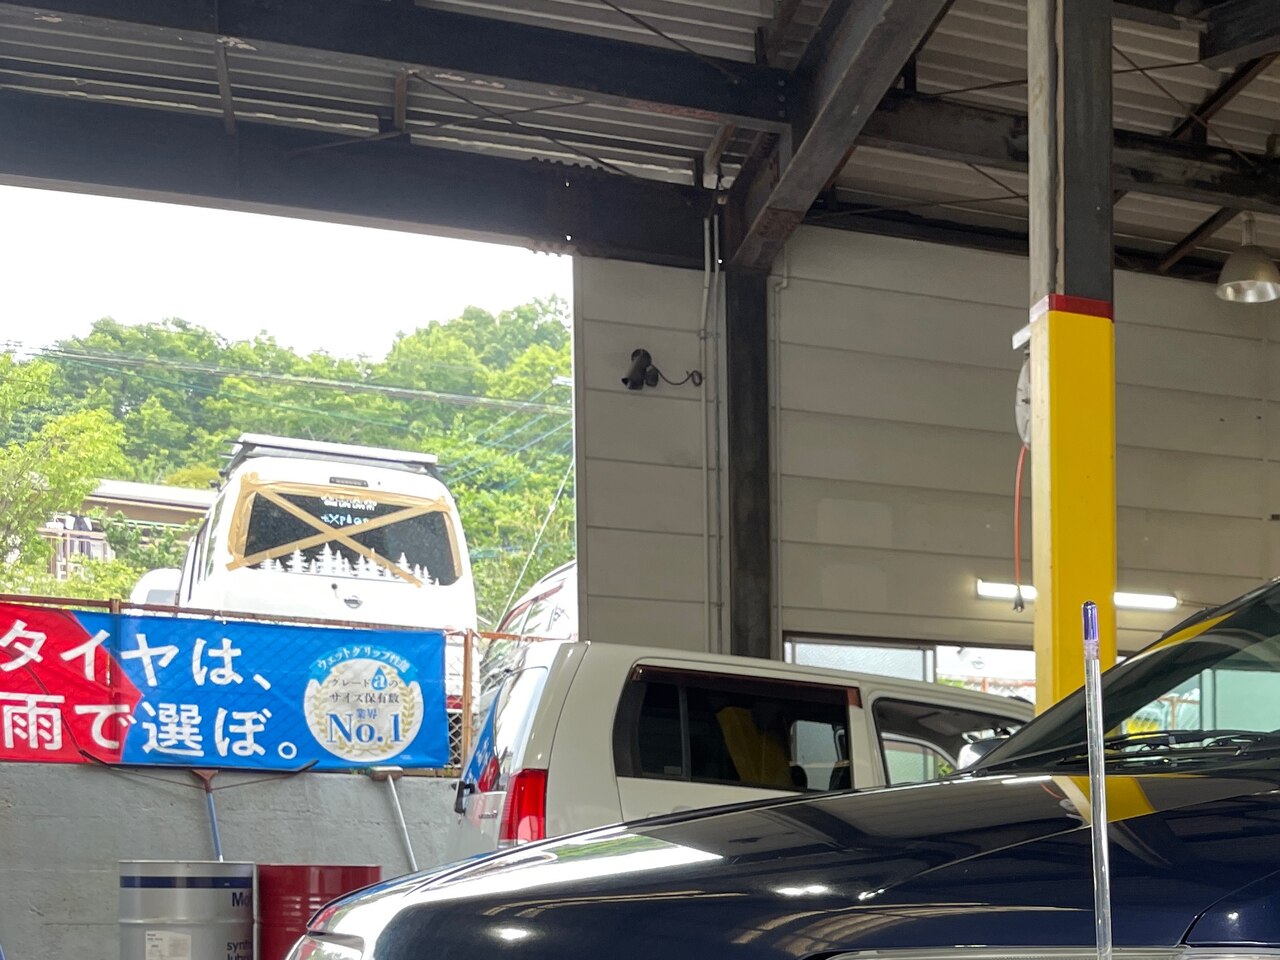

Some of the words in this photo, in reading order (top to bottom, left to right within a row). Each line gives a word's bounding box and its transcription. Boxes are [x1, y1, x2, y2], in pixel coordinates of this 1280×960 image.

[0, 619, 272, 691] タイヤは、
[317, 646, 411, 673] ウェットグリップ性能
[329, 692, 400, 704] サイズ保有数
[0, 691, 298, 760] 雨で選ぼ。
[355, 708, 378, 720] 業界
